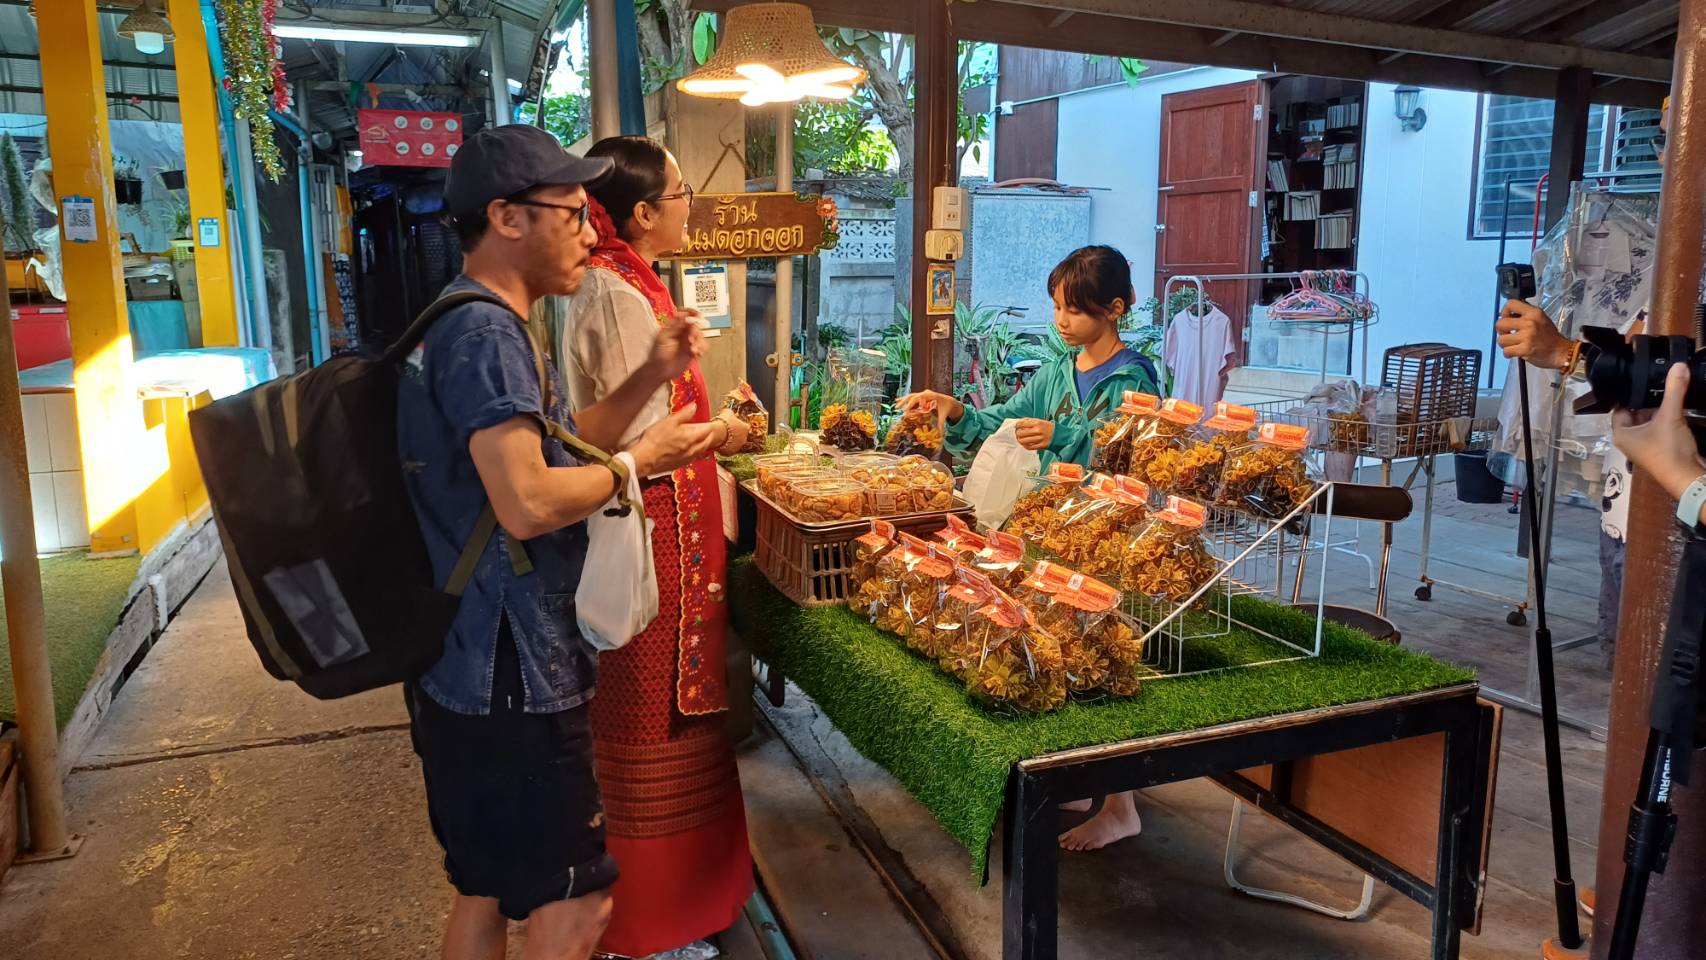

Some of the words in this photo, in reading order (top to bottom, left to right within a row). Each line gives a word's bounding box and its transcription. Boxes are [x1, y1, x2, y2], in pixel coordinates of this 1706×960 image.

[714, 195, 758, 226] ร้าน
[672, 225, 804, 255] นมดอกจอก
